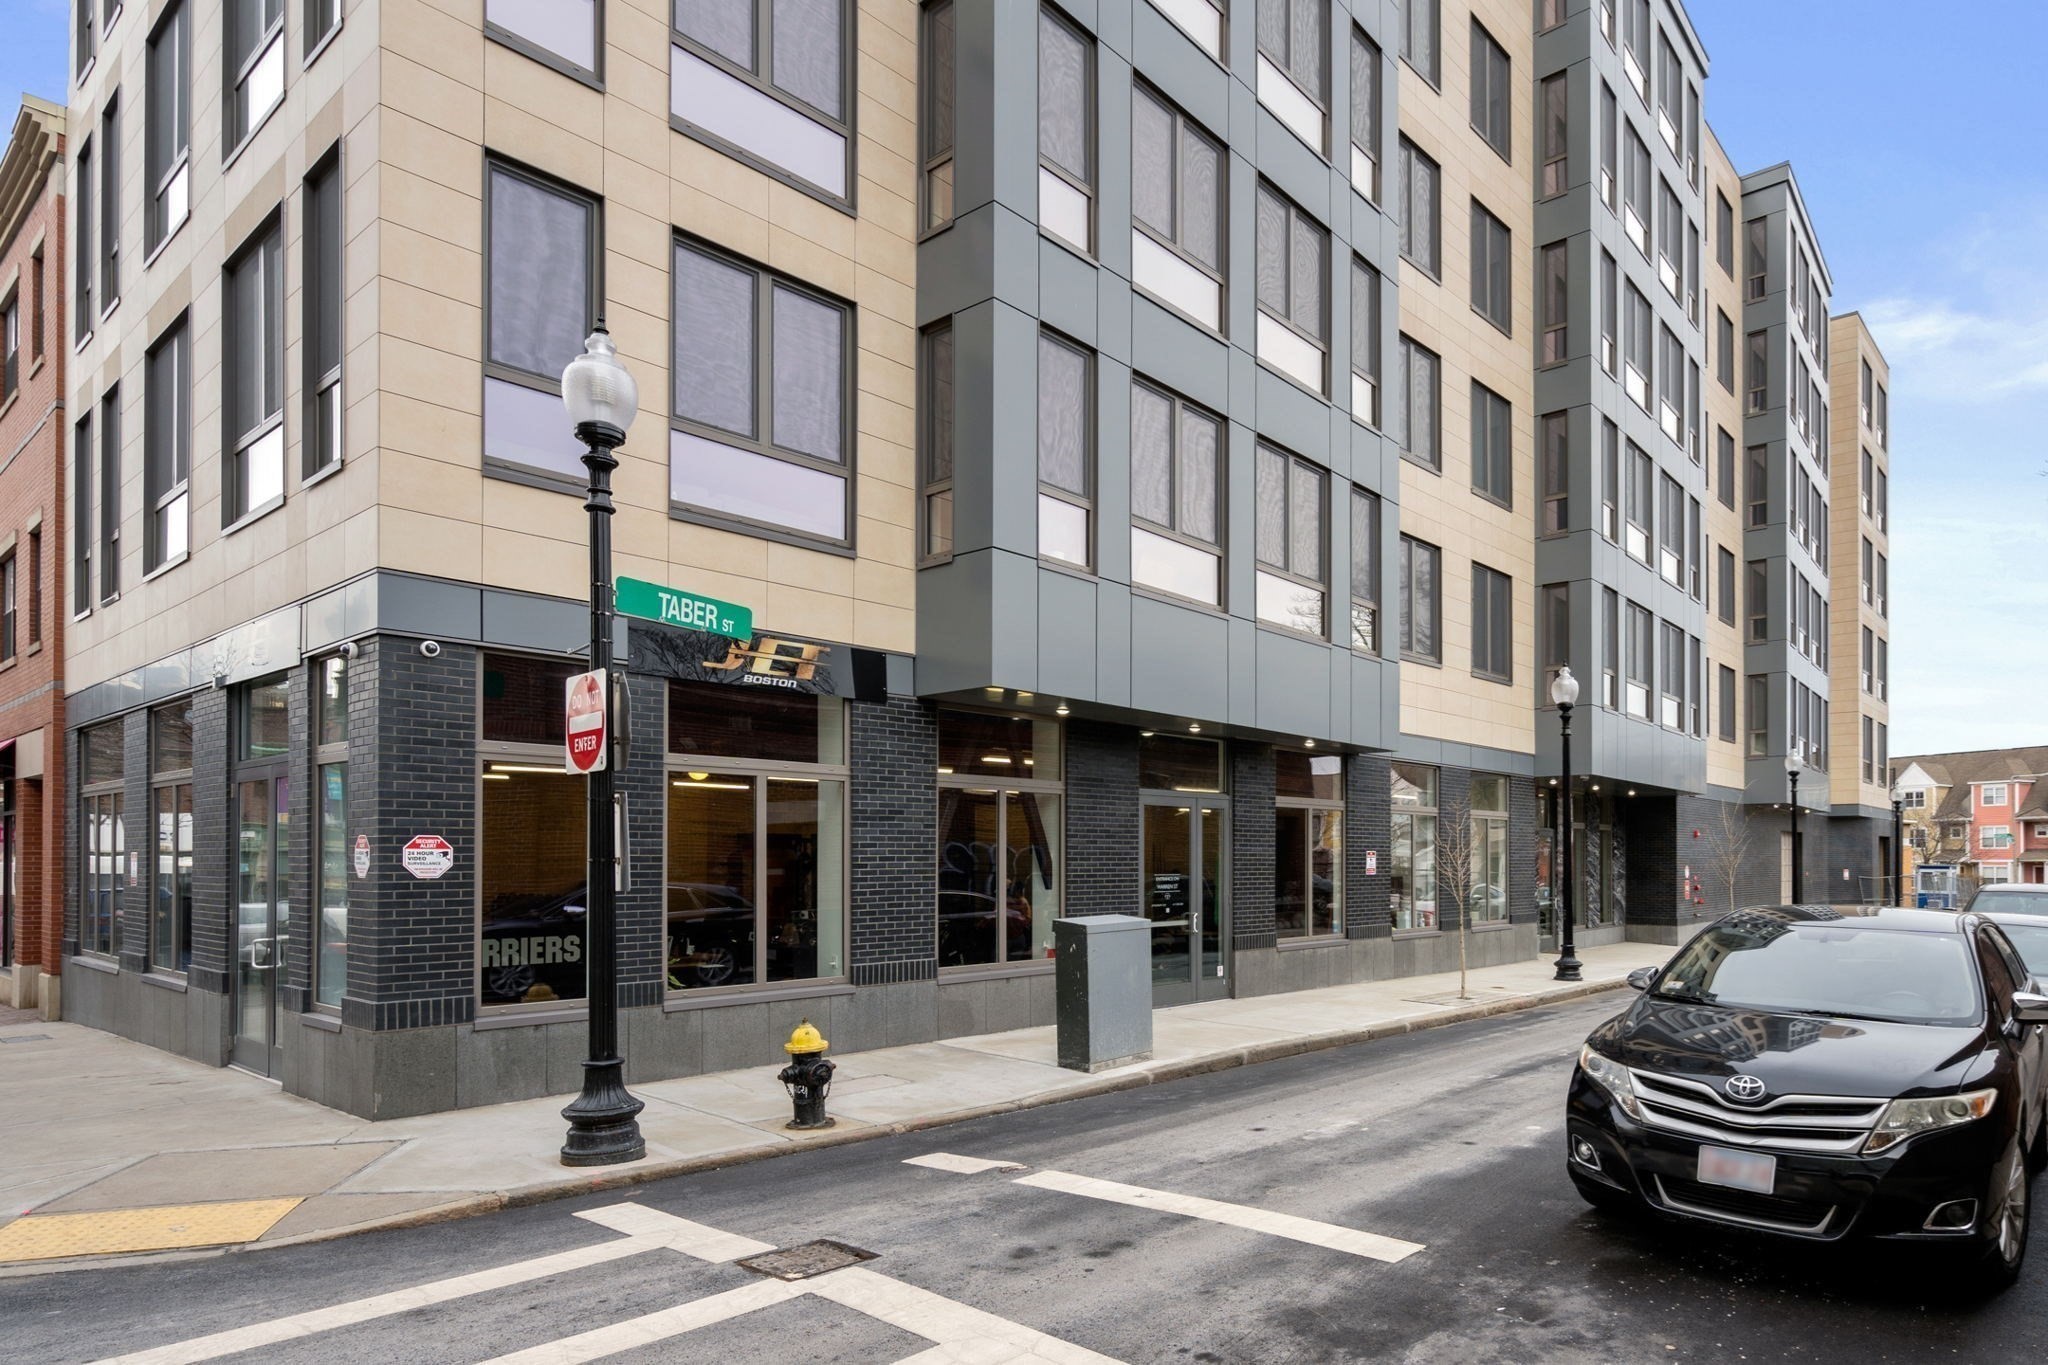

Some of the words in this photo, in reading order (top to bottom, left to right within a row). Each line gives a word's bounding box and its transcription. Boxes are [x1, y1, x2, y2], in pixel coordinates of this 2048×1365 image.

[658, 592, 717, 629] TABER
[722, 619, 734, 633] ST
[743, 674, 798, 688] BOSTON
[572, 694, 582, 709] DO
[587, 689, 600, 705] NOT
[574, 735, 597, 753] ENTER
[482, 935, 581, 968] RRIERS
